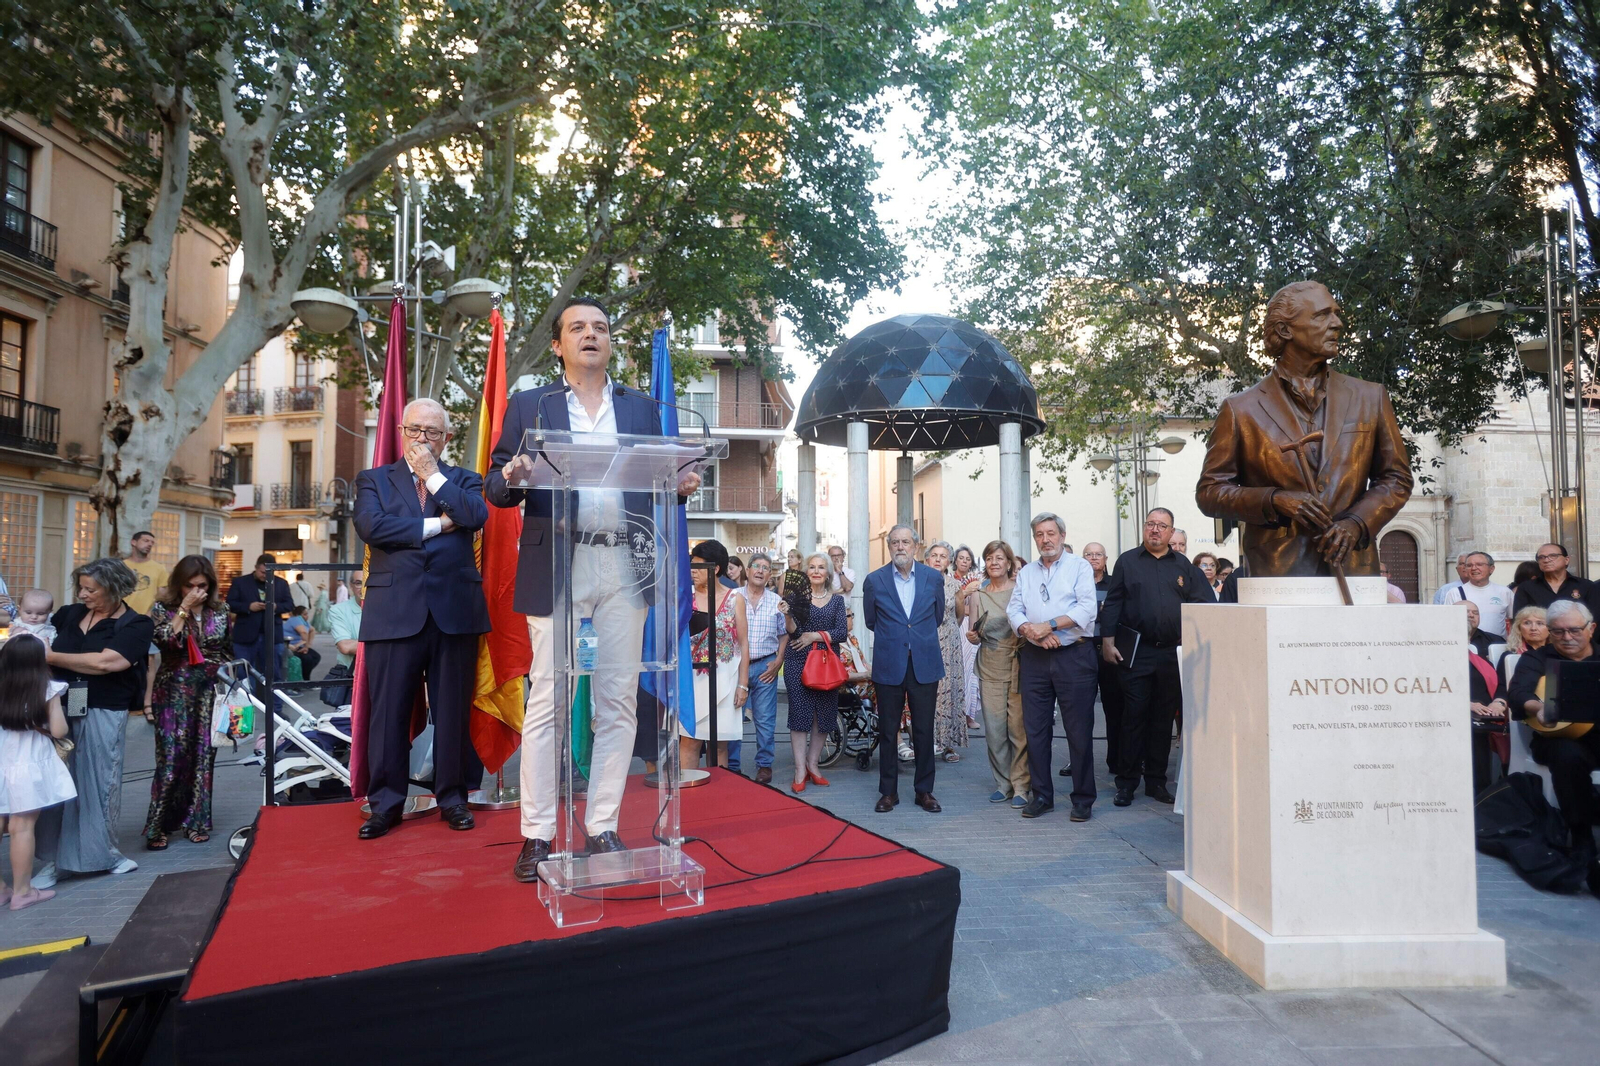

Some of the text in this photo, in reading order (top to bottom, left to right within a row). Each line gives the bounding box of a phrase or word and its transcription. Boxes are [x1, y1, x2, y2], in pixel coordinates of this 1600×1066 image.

[736, 545, 769, 554] OYSHO
[1289, 677, 1453, 697] ANTONIO GALA
[1350, 704, 1369, 712] (1930
[1373, 704, 1392, 712] 2023)
[1292, 723, 1317, 731] POETA,
[1318, 722, 1358, 730] NOVELISTA,
[1358, 721, 1408, 729] DRAMATURGO
[1316, 801, 1364, 810] AYUNTAMIENTO
[1316, 810, 1354, 819] DE CÓRDOBA
